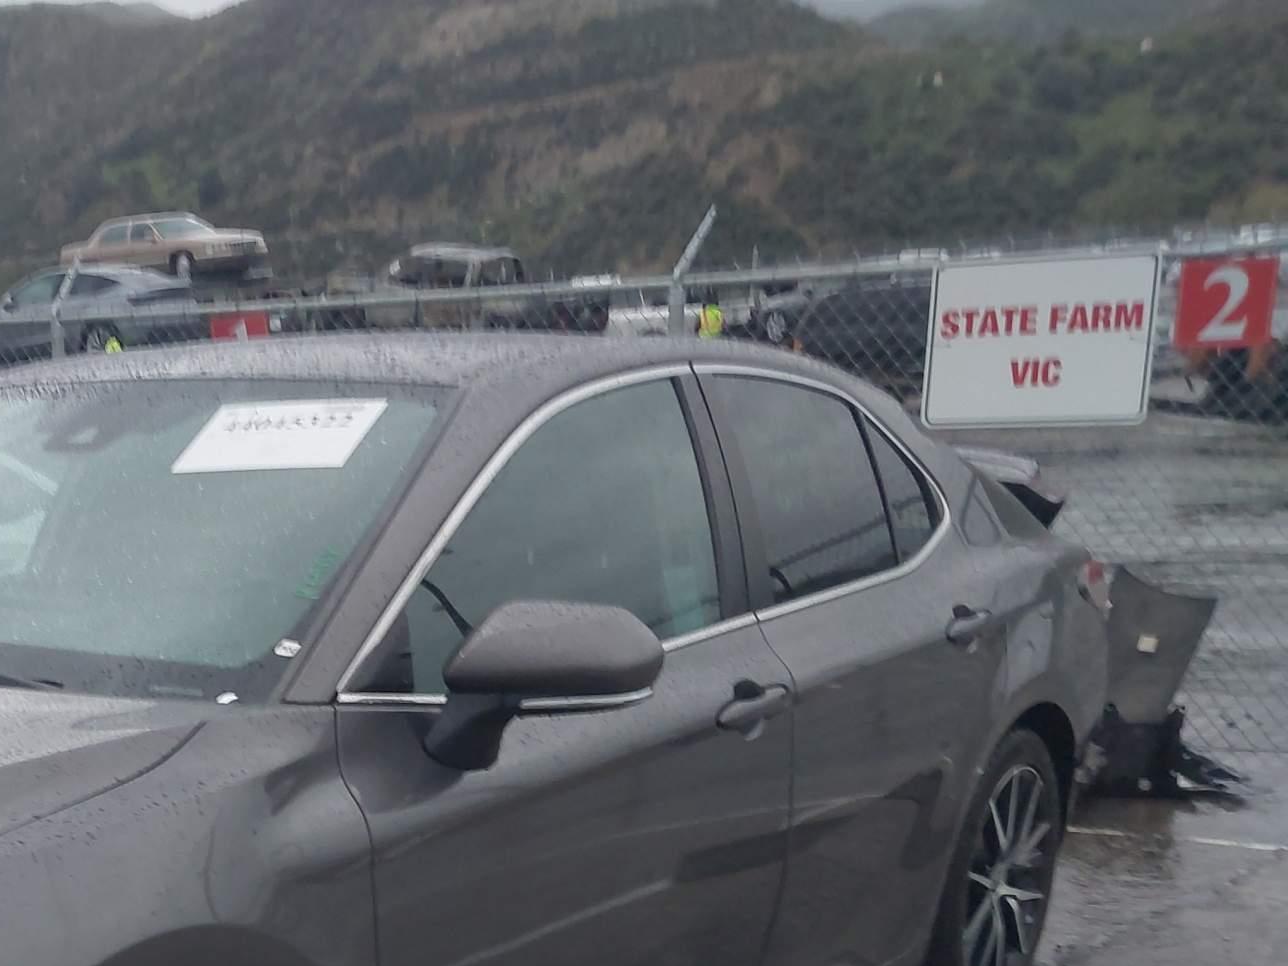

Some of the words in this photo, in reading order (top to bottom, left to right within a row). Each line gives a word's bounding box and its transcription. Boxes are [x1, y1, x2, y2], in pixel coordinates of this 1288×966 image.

[940, 306, 1038, 339] STATE
[1048, 302, 1145, 334] FARM
[1197, 265, 1249, 343] 2
[1010, 358, 1063, 388] VIC
